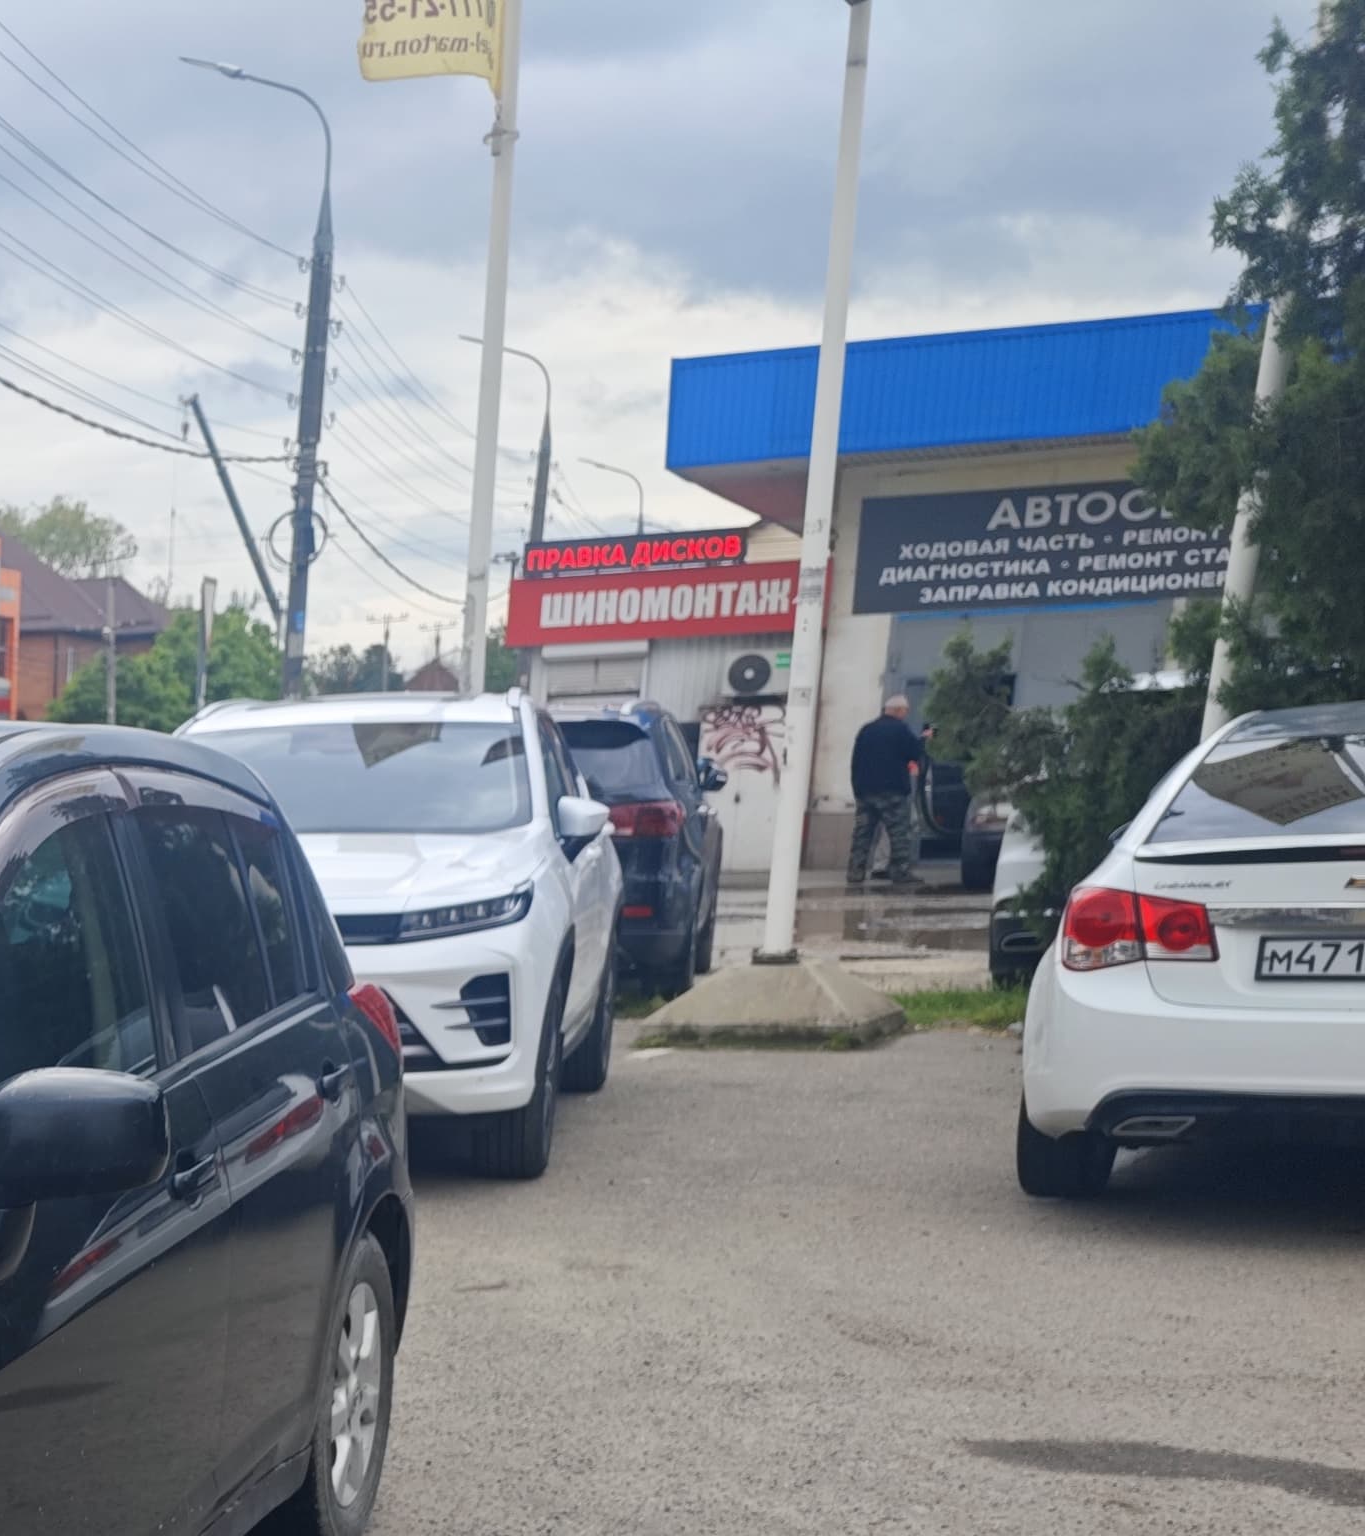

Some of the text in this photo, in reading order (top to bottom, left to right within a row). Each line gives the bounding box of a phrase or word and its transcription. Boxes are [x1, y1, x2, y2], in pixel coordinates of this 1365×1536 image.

[526, 535, 742, 571] ПРАВКА ДИСКОВ
[899, 537, 1010, 560] ХОДОВАЯ
[1017, 533, 1095, 553] ЧАСТЬ
[879, 558, 1051, 586] ДИАГНОСТИКА
[1078, 550, 1178, 572] РЕМОНТ
[540, 578, 792, 629] ШИНОМОНТАЖ
[919, 582, 1041, 604] ЗАПРАВКА
